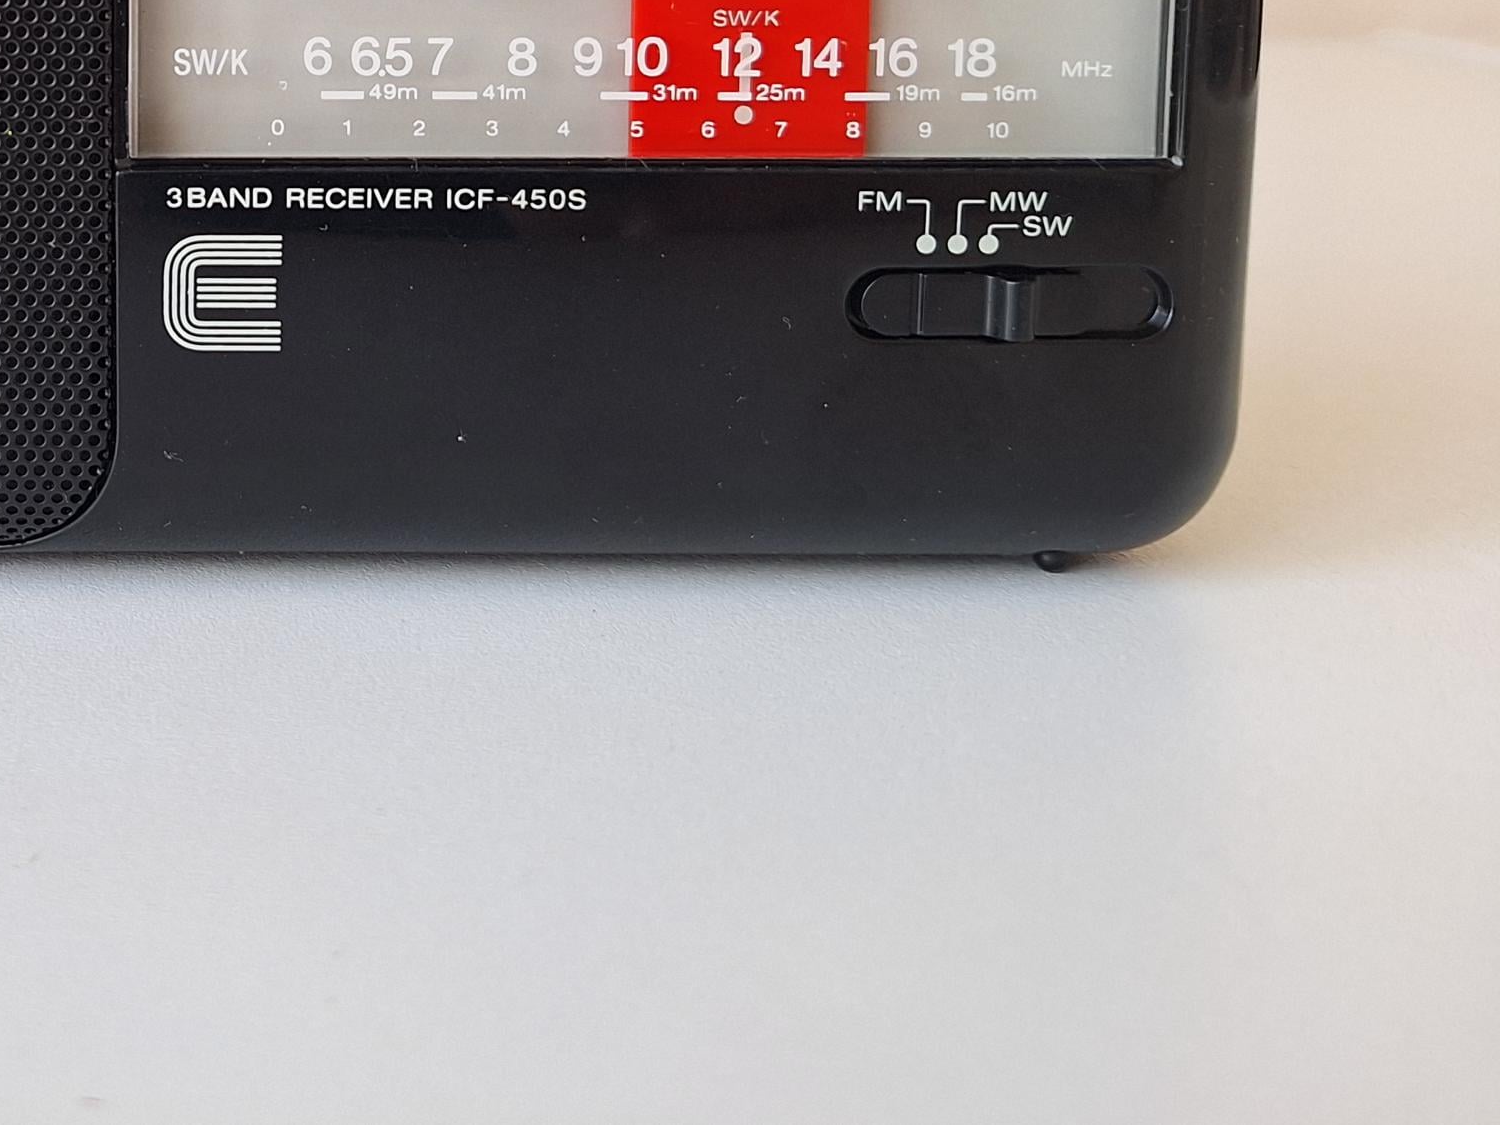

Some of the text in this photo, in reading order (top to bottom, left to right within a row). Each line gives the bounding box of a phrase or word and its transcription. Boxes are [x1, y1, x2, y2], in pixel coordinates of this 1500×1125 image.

[714, 10, 779, 27] SW/K
[174, 37, 1112, 77] SW/K 6 6.5 7 8 9 10 12 14 16 18 MHz
[369, 84, 1036, 101] 49m 41m 31m 25m 19m 16m
[272, 120, 1009, 138] 0 1 2 3 4 5 6 7 8 9 10
[167, 188, 586, 210] 3BAND RECEIVER ICF-450S
[859, 191, 1048, 211] FM MW
[1023, 216, 1072, 236] SW
